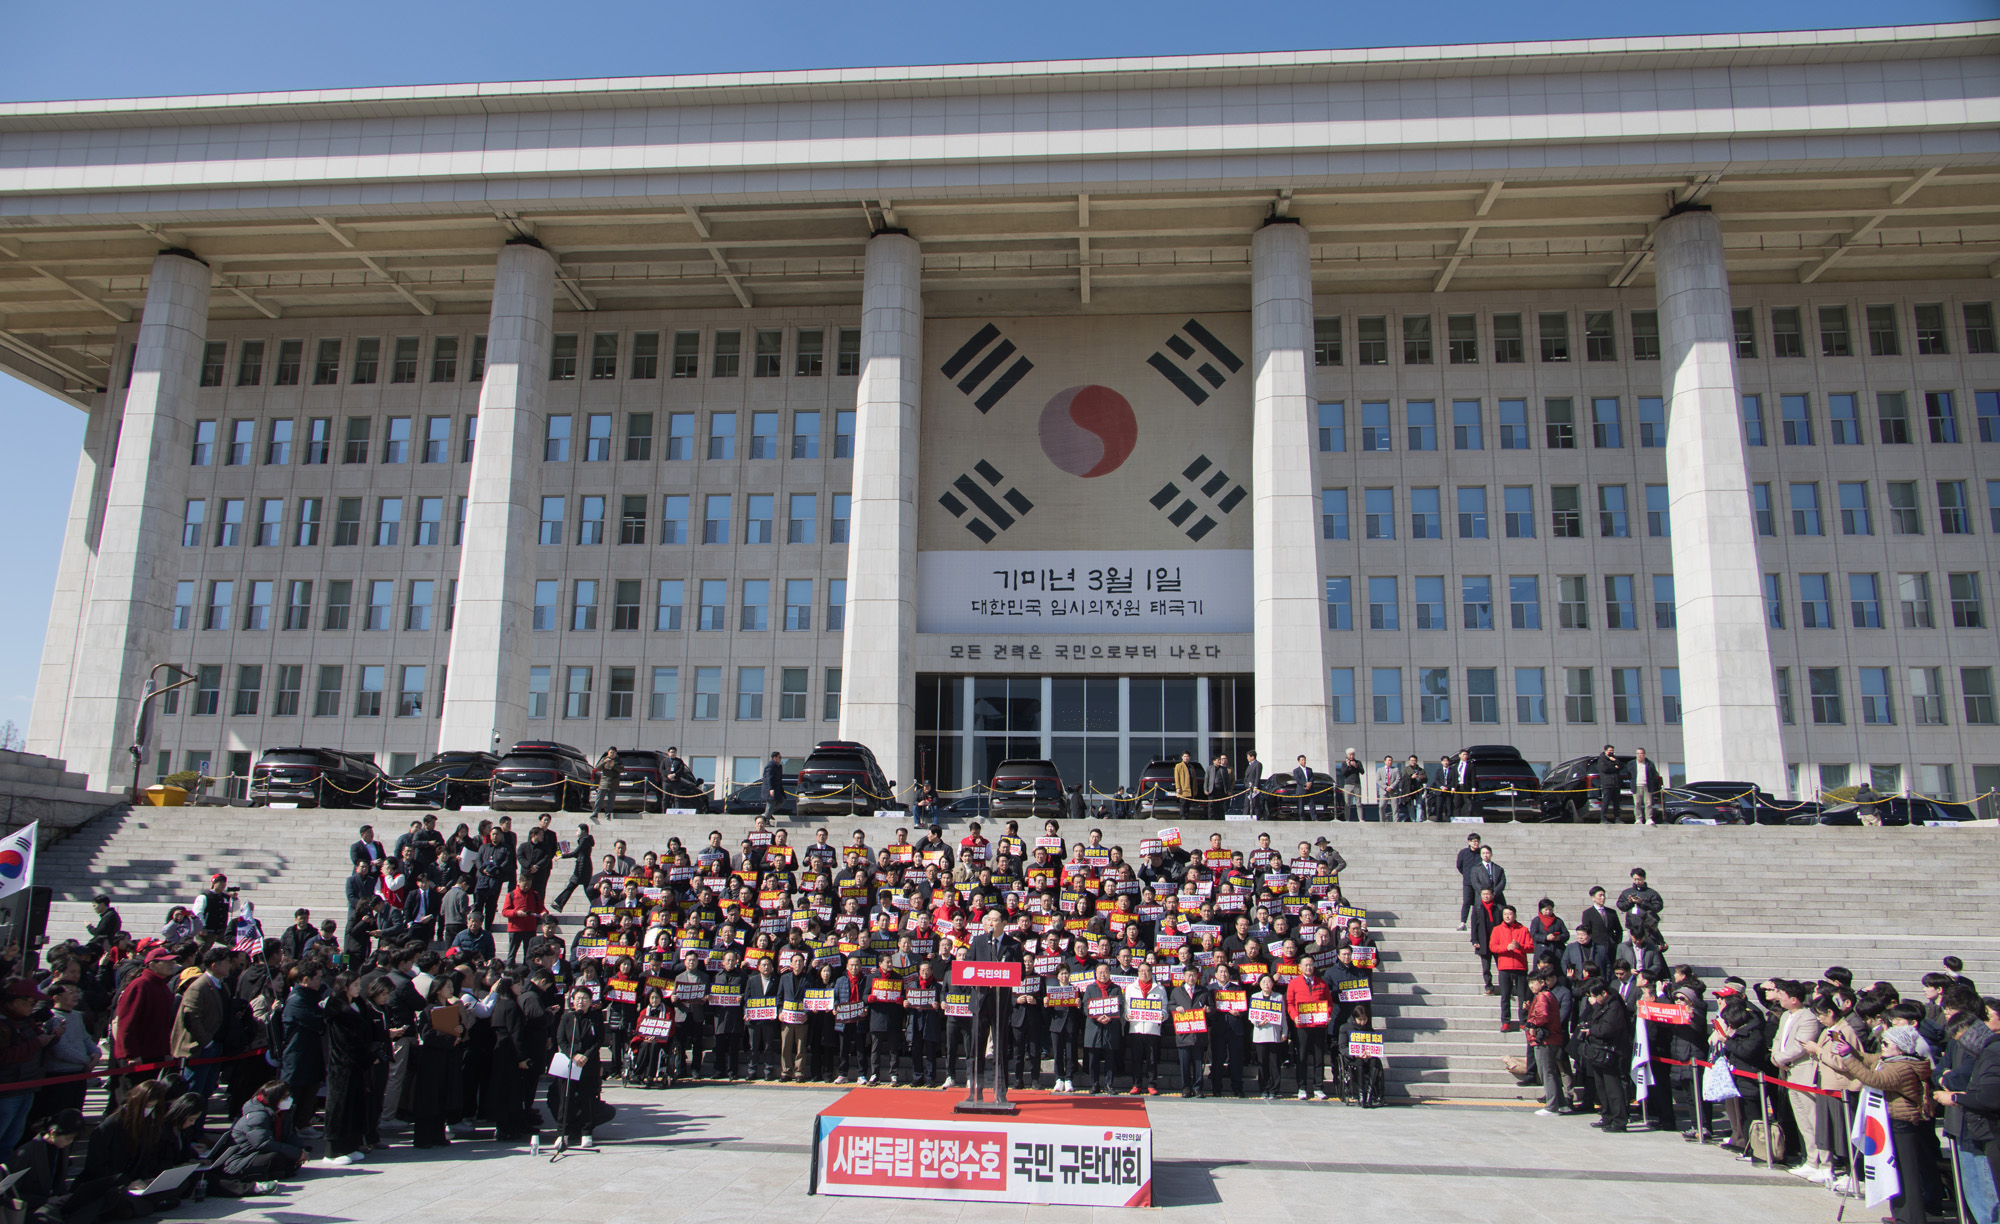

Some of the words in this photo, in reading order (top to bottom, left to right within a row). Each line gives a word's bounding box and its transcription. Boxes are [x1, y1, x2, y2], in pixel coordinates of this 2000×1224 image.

[993, 568, 1075, 592] 기미년
[1088, 567, 1133, 593] 3월
[1147, 567, 1182, 592] 1일
[972, 599, 1042, 617] 대한민국
[1051, 599, 1140, 617] 임시의정원
[1150, 599, 1203, 616] 태극기
[950, 646, 982, 659] 모든
[994, 645, 1042, 659] 권력은
[1055, 645, 1157, 659] 국민으로부터
[1170, 645, 1221, 659] 나온다
[1339, 907, 1356, 916] 삼권분립
[1357, 908, 1366, 917] 파괴
[977, 969, 1010, 979] 국민의힘
[1240, 965, 1258, 973] 사법파괴
[1278, 965, 1298, 973] 사법파괴
[874, 980, 893, 990] 사법파괴
[894, 982, 902, 990] 3법
[1026, 977, 1040, 985] 파괴
[1339, 980, 1357, 990] 삼권분립
[1358, 979, 1369, 988] 파괴
[711, 985, 730, 994] 삼권분립
[730, 986, 740, 994] 파괴
[805, 990, 823, 998] 삼권분립
[824, 990, 834, 998] 파괴
[946, 994, 965, 1003] 삼권분립
[1216, 992, 1235, 1000] 사법파괴
[1236, 992, 1245, 1000] 3법
[747, 999, 765, 1007] 삼권분립
[766, 998, 776, 1006] 파괴
[1089, 999, 1103, 1008] 사법
[1104, 997, 1118, 1006] 파괴
[1131, 1000, 1150, 1008] 삼권분립
[1151, 1001, 1161, 1010] 파괴
[1251, 1000, 1270, 1010] 삼권분립
[1272, 1002, 1282, 1012] 파괴
[1298, 1003, 1317, 1012] 사법파괴
[1318, 1002, 1328, 1012] 3법
[837, 1004, 850, 1012] 사법
[1089, 1007, 1103, 1015] 독재
[1104, 1005, 1119, 1013] 완성
[1174, 1012, 1194, 1021] 사법파괴
[1194, 1010, 1204, 1020] 3법
[1250, 1010, 1259, 1019] 당장
[654, 1028, 669, 1036] 완성
[1350, 1032, 1371, 1042] 삼권분립
[1372, 1033, 1382, 1043] 파괴
[1350, 1044, 1360, 1054] 당장
[1115, 1132, 1142, 1142] 국민의힘
[833, 1136, 914, 1178] 사법독립
[919, 1138, 1001, 1181] 헌정수호
[1013, 1142, 1054, 1183] 국민
[1059, 1143, 1142, 1187] 규탄대회
